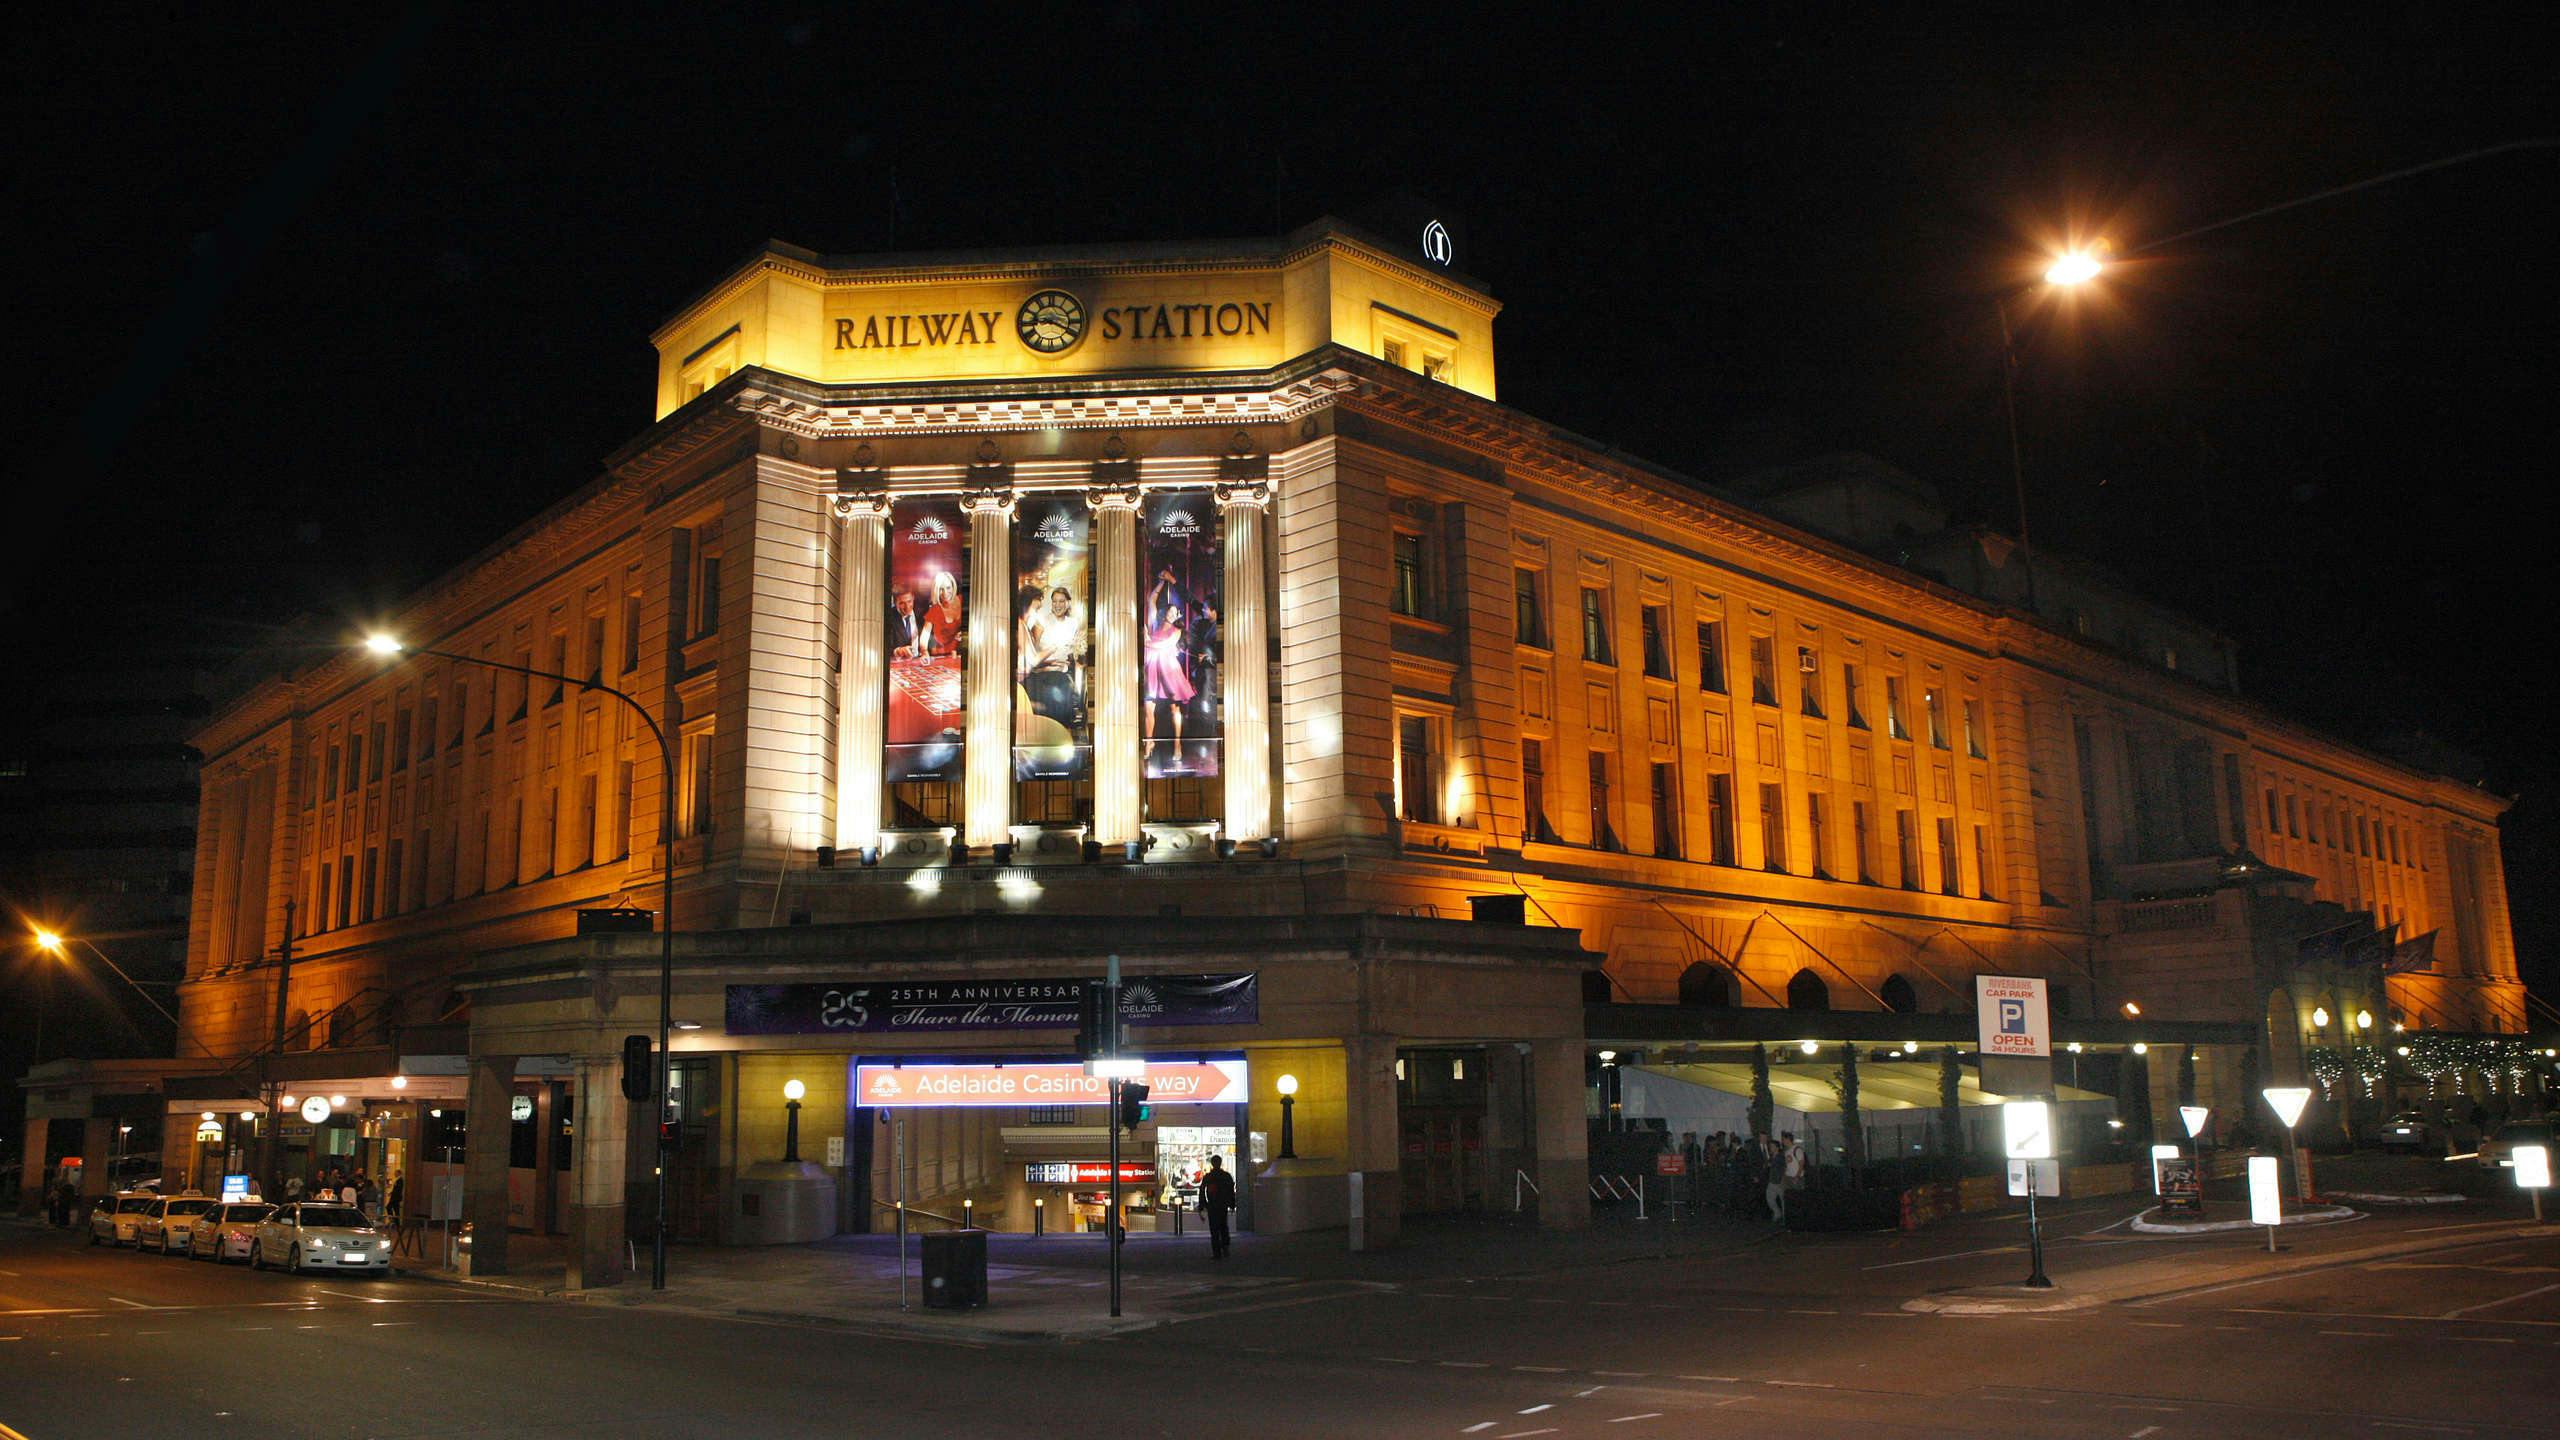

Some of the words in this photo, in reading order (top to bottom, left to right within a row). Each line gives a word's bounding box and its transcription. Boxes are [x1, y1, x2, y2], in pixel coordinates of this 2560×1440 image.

[834, 310, 1001, 350] RAILWAY
[1102, 303, 1272, 342] STATION
[1033, 530, 1074, 539] ADELAIDE
[1159, 525, 1200, 533] ADELAIDE
[907, 531, 949, 540] ADELAIDE
[891, 988, 938, 1000] 25TH
[951, 985, 1080, 1000] ANNIVERSAR
[1986, 989, 2006, 997] CAR
[2009, 990, 2034, 998] PARK
[891, 1008, 958, 1026] Share
[960, 1002, 991, 1025] the
[993, 1004, 1080, 1024] Momen
[2002, 1003, 2022, 1029] P
[1992, 1035, 2034, 1046] OPEN
[2003, 1046, 2036, 1055] HOURS
[915, 1074, 1016, 1095] Adelaide
[1022, 1073, 1099, 1093] Casino
[1154, 1075, 1201, 1095] way
